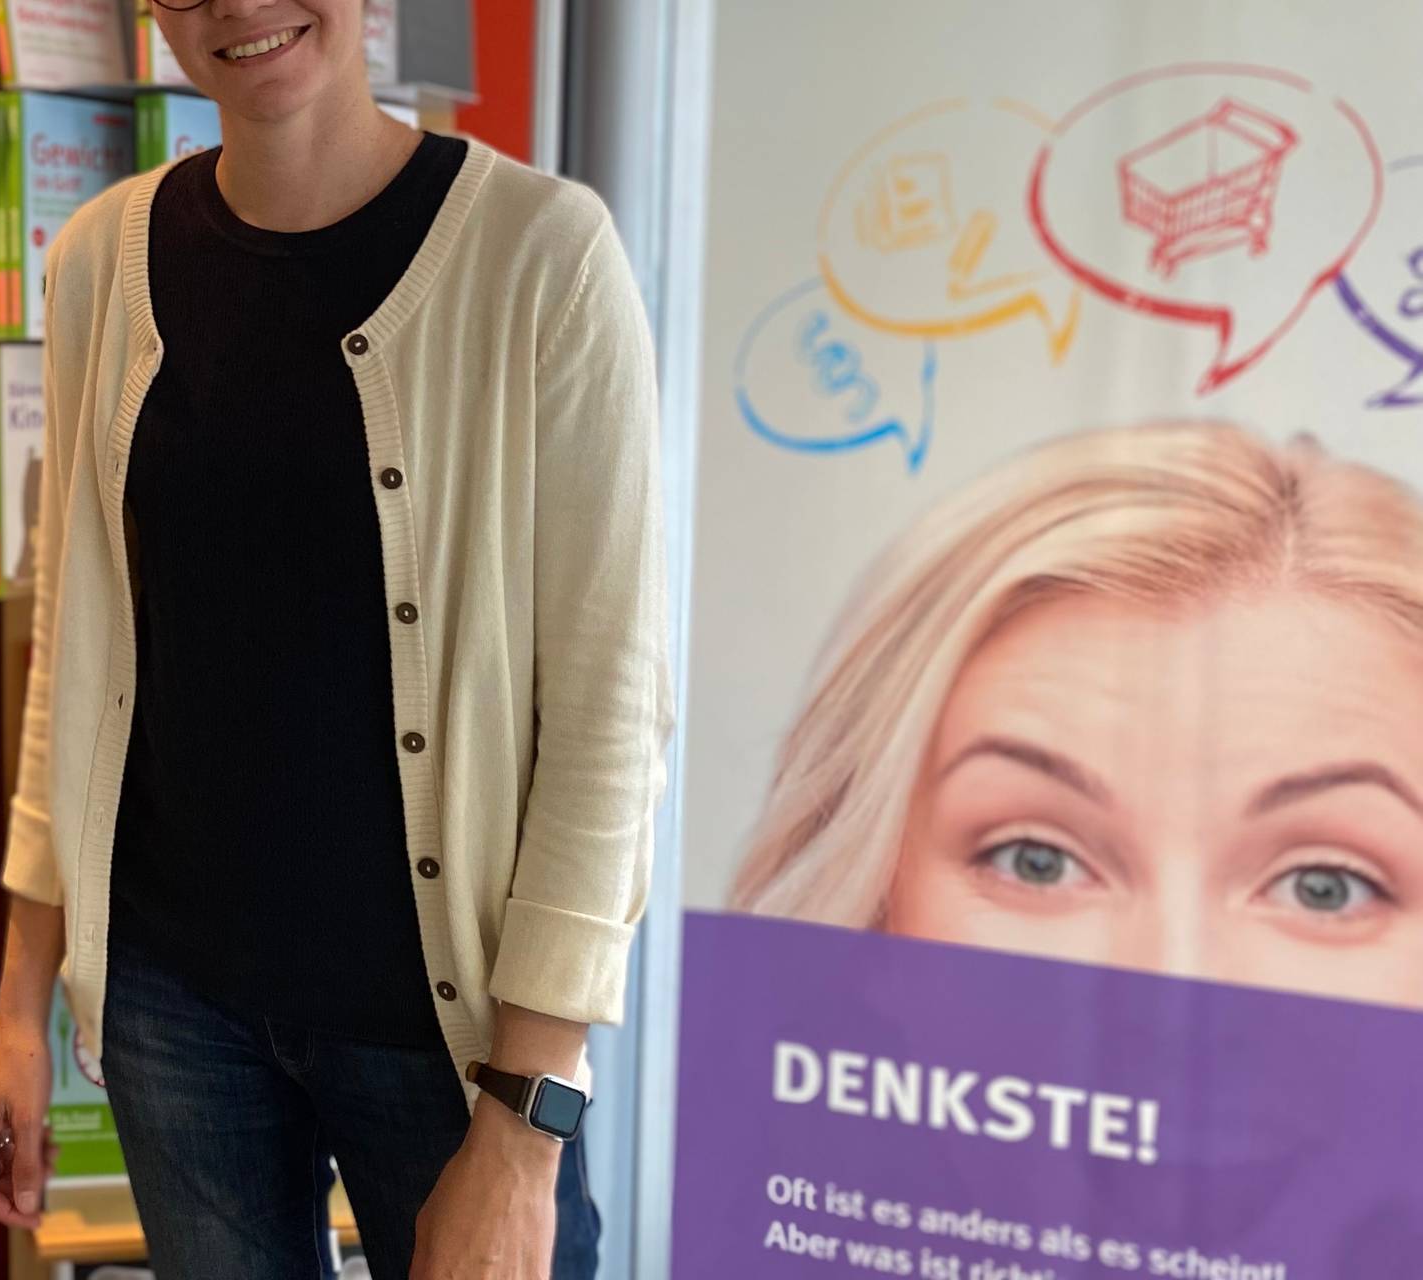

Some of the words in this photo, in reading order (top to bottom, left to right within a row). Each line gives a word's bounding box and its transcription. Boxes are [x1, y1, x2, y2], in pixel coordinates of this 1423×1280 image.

[773, 1041, 1160, 1164] DENKSTE!
[764, 1219, 841, 1263] Aber
[845, 1238, 914, 1277] was
[920, 1246, 962, 1280] ist
[766, 1173, 818, 1211] Oft
[825, 1181, 866, 1221] ist
[872, 1199, 912, 1229] es
[918, 1208, 1033, 1250] anders
[1039, 1223, 1092, 1262] als
[1098, 1238, 1142, 1271] es
